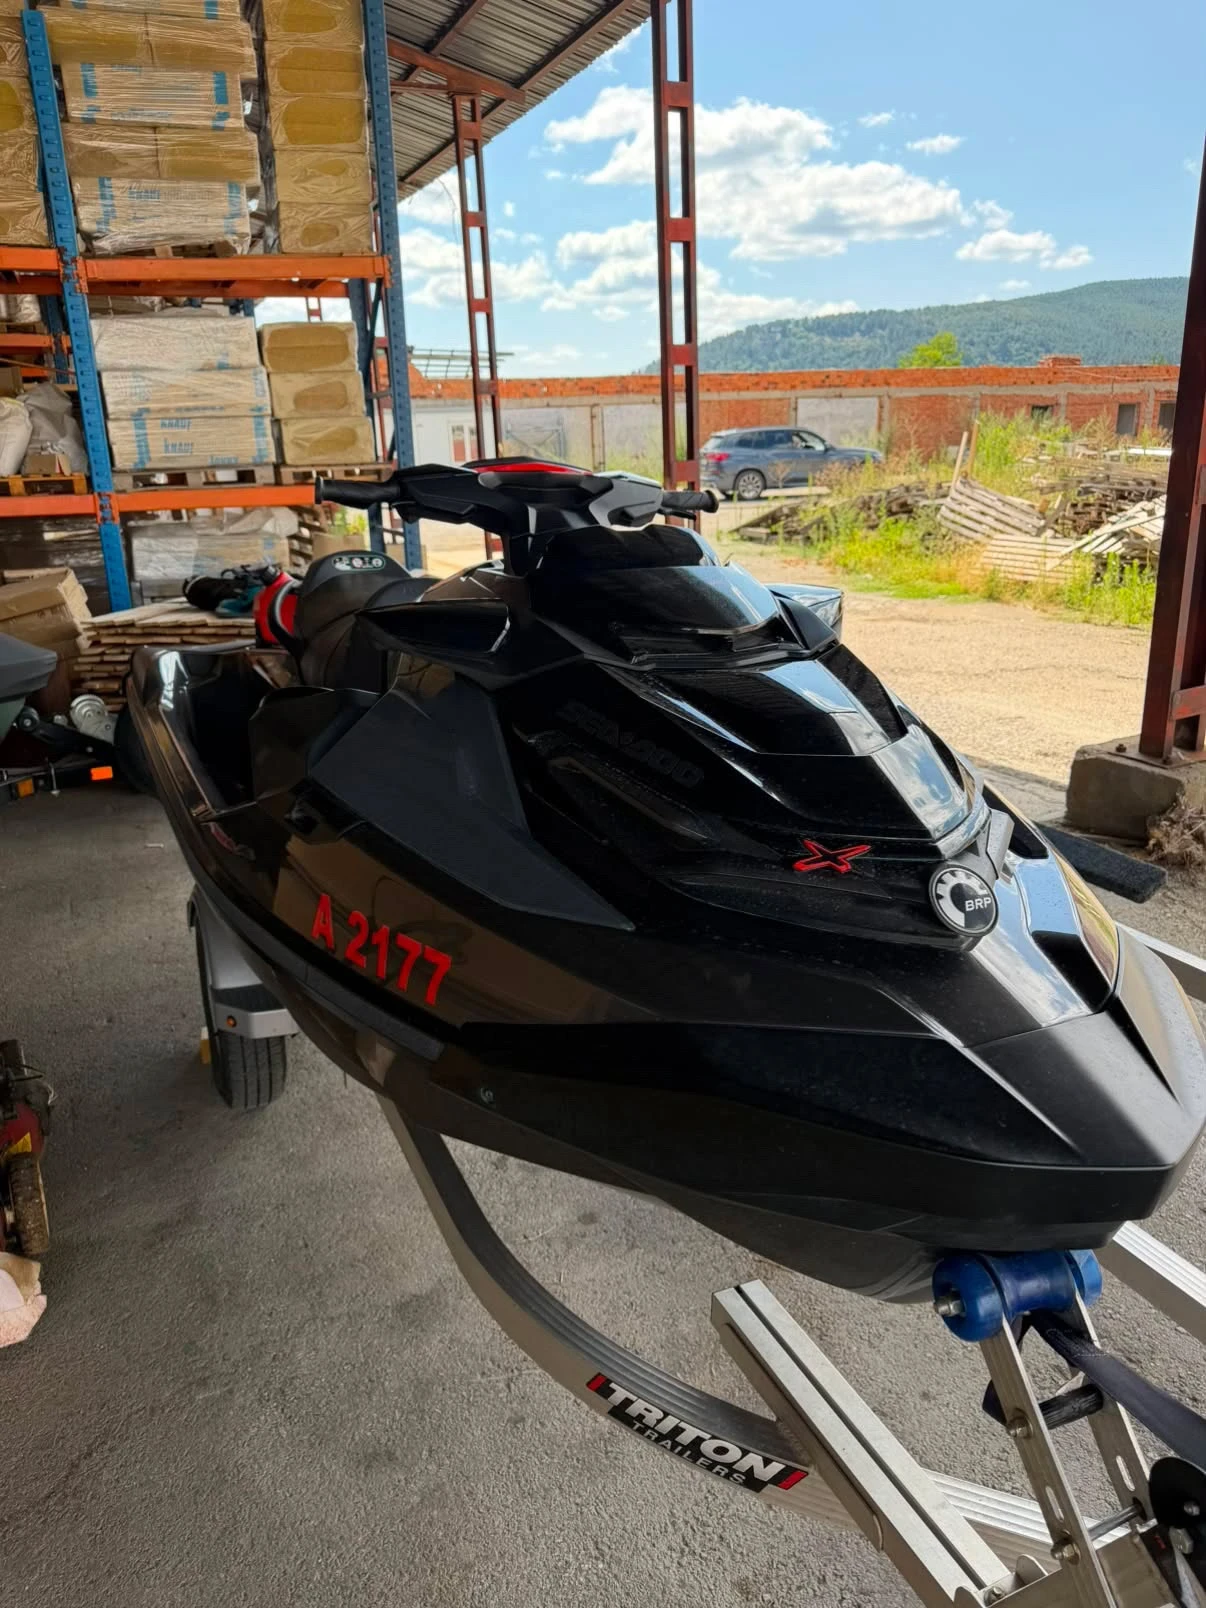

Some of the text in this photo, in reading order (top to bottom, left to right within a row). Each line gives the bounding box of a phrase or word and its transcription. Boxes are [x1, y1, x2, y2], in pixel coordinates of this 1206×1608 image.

[964, 897, 992, 912] BRP
[311, 892, 452, 1006] A 2177
[605, 1383, 785, 1481] TRITON
[632, 1420, 747, 1485] TRAILERS
